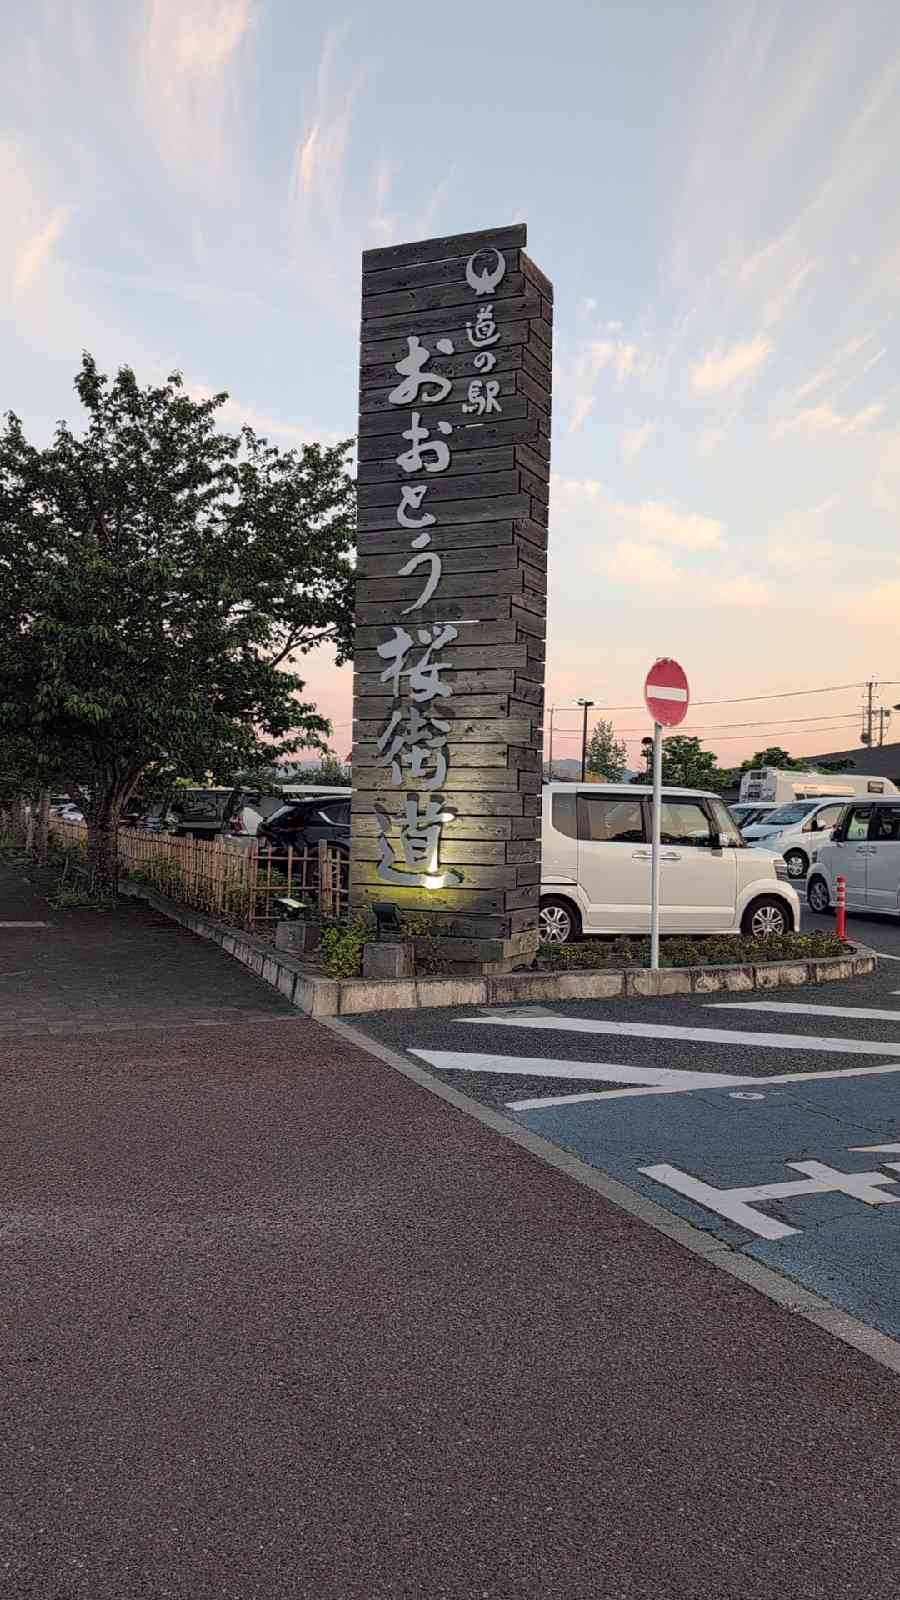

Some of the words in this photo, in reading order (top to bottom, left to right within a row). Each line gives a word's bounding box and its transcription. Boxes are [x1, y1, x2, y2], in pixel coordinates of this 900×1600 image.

[462, 304, 502, 416] 道の駅
[376, 335, 461, 889] おおとう桜街道
